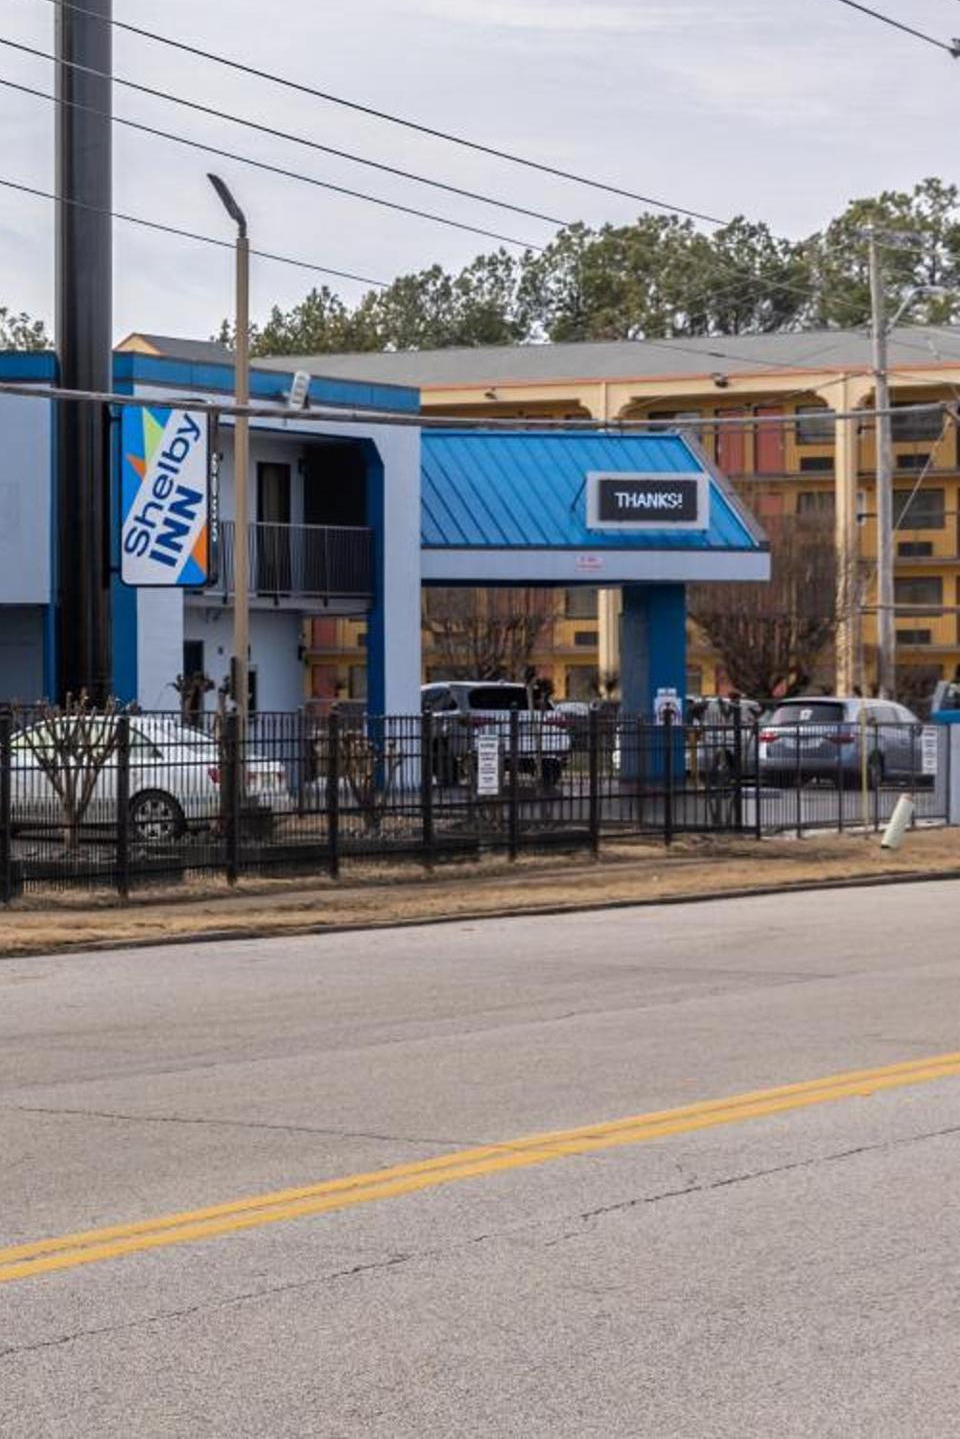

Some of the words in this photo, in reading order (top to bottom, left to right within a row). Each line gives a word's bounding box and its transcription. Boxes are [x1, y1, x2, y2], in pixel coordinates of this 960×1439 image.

[124, 413, 201, 557] Shelby
[149, 485, 203, 567] INN
[614, 492, 683, 508] THANKS!
